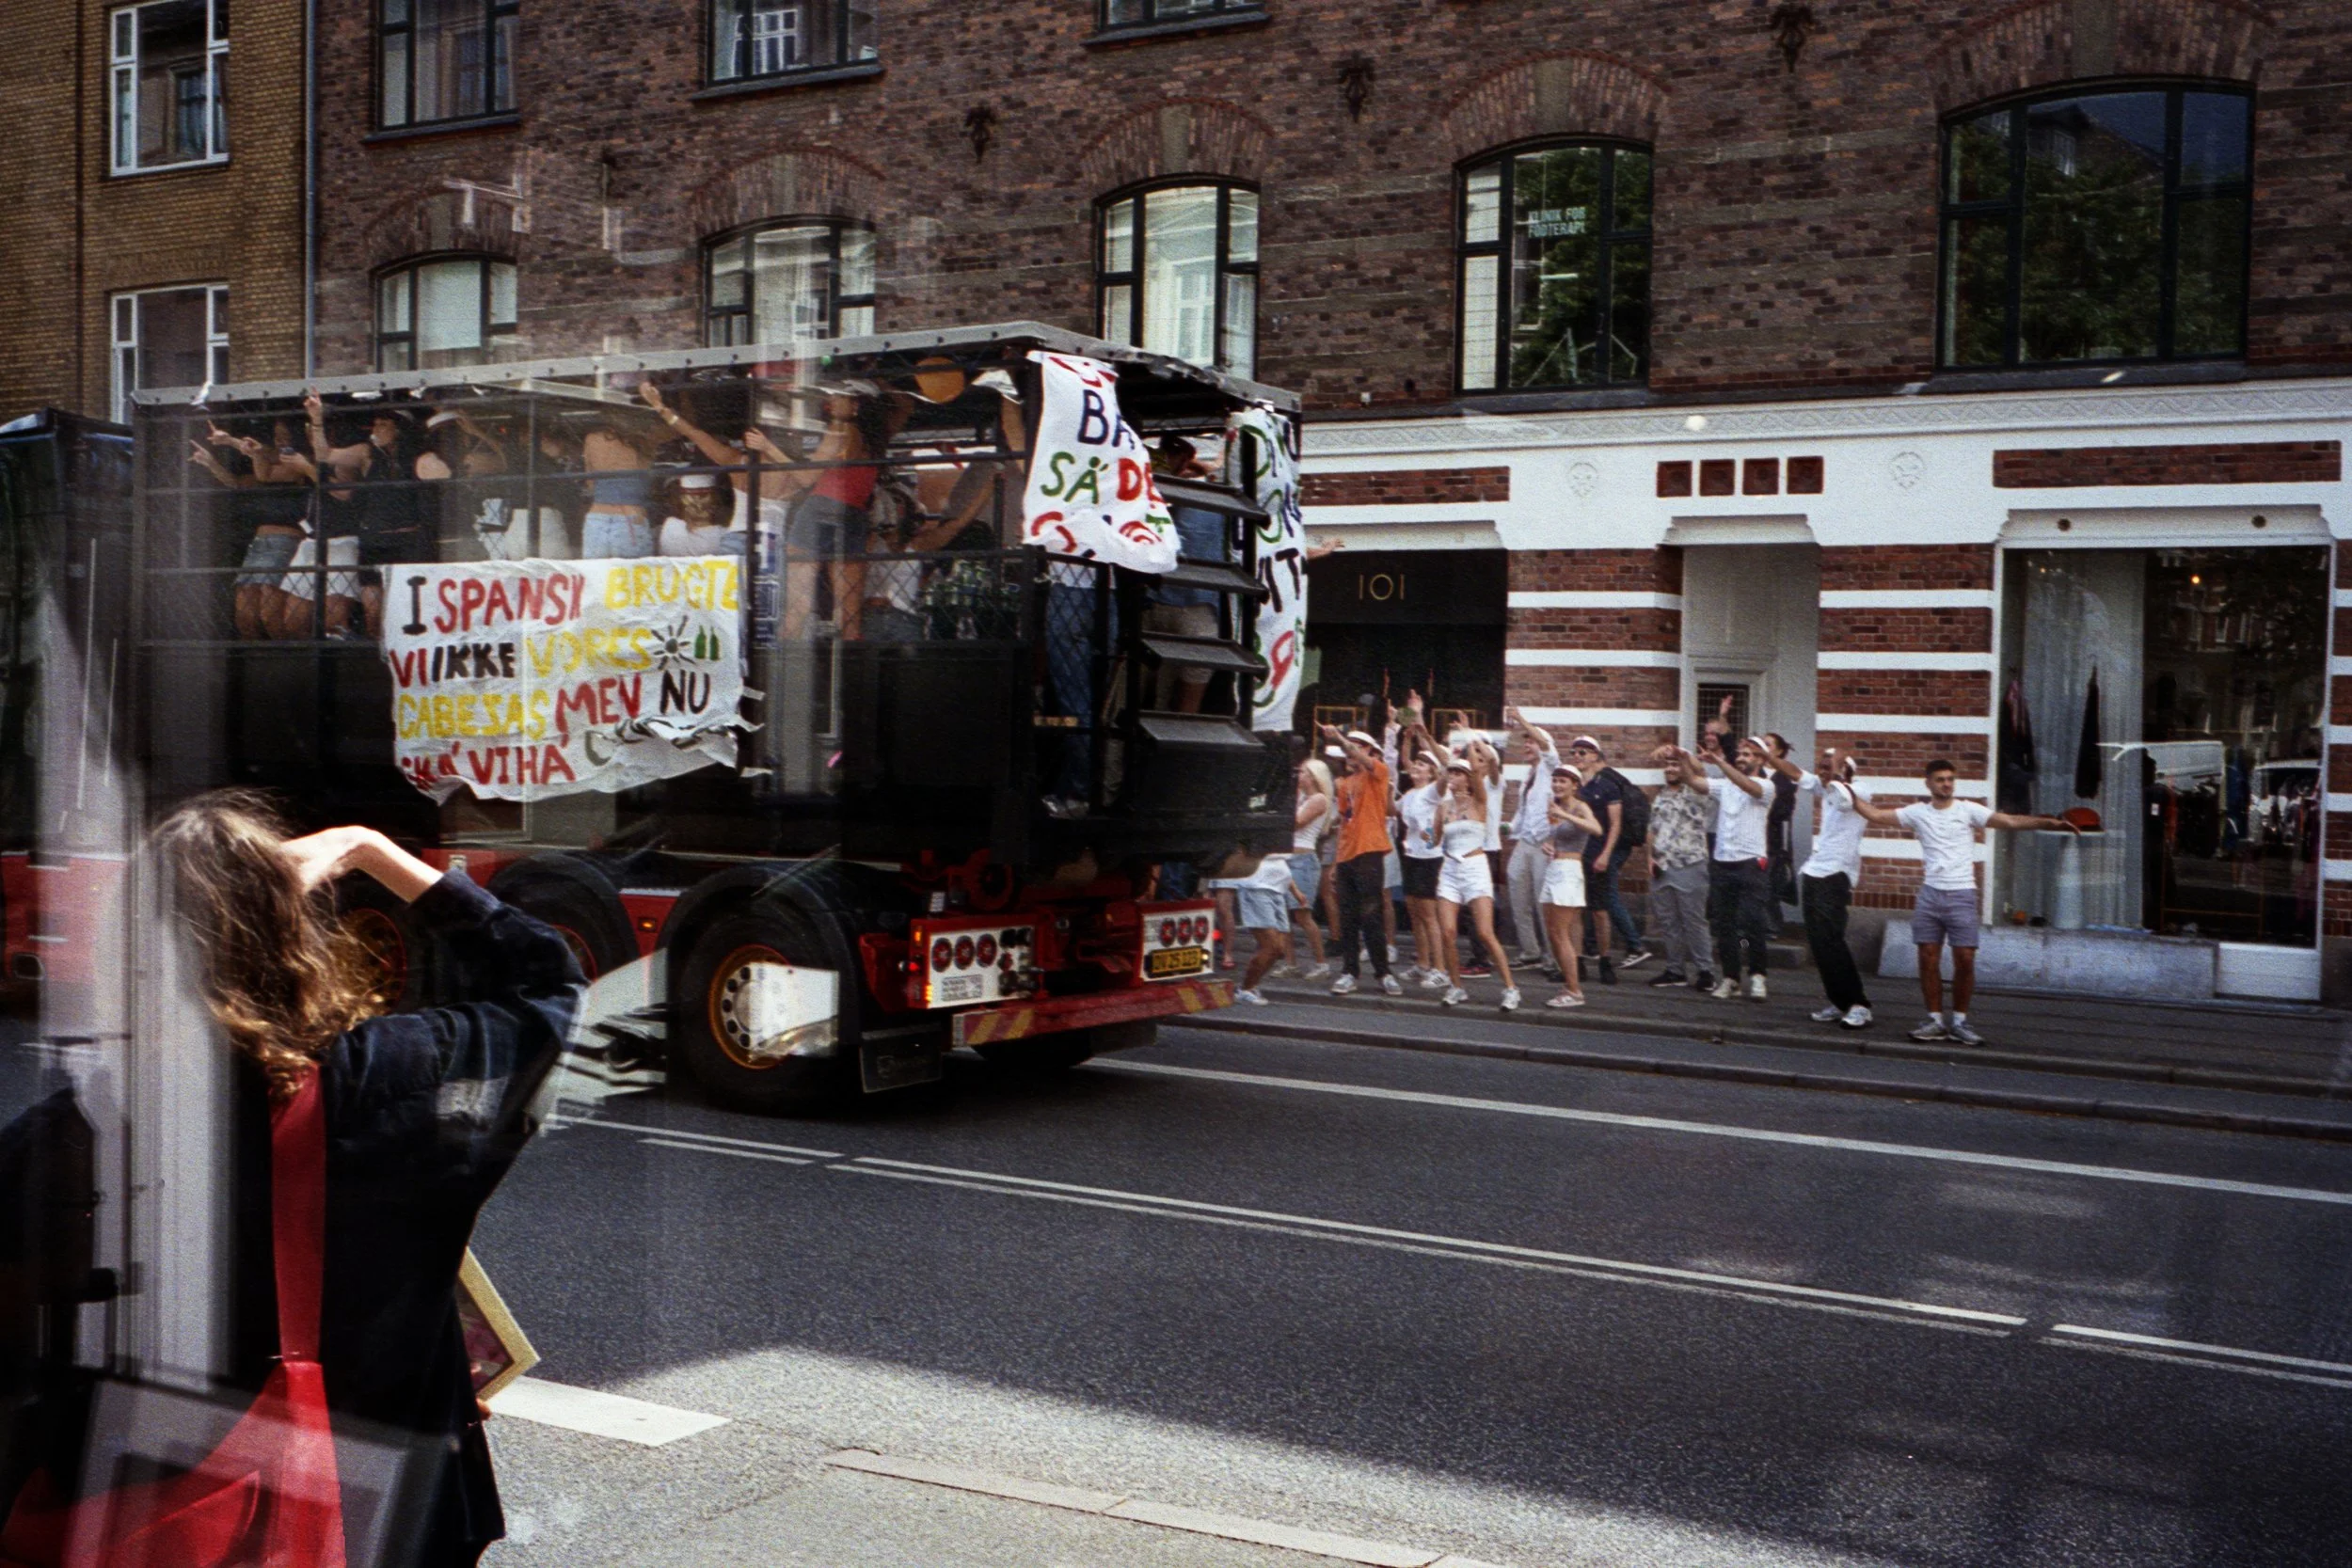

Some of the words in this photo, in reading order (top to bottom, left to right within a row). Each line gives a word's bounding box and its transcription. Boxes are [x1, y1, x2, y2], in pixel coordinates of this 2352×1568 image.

[401, 575, 428, 637] I
[389, 647, 427, 689] VI
[431, 641, 516, 683] IKKE
[526, 626, 653, 678] VORES
[660, 669, 711, 715] NU
[467, 745, 511, 785] VI
